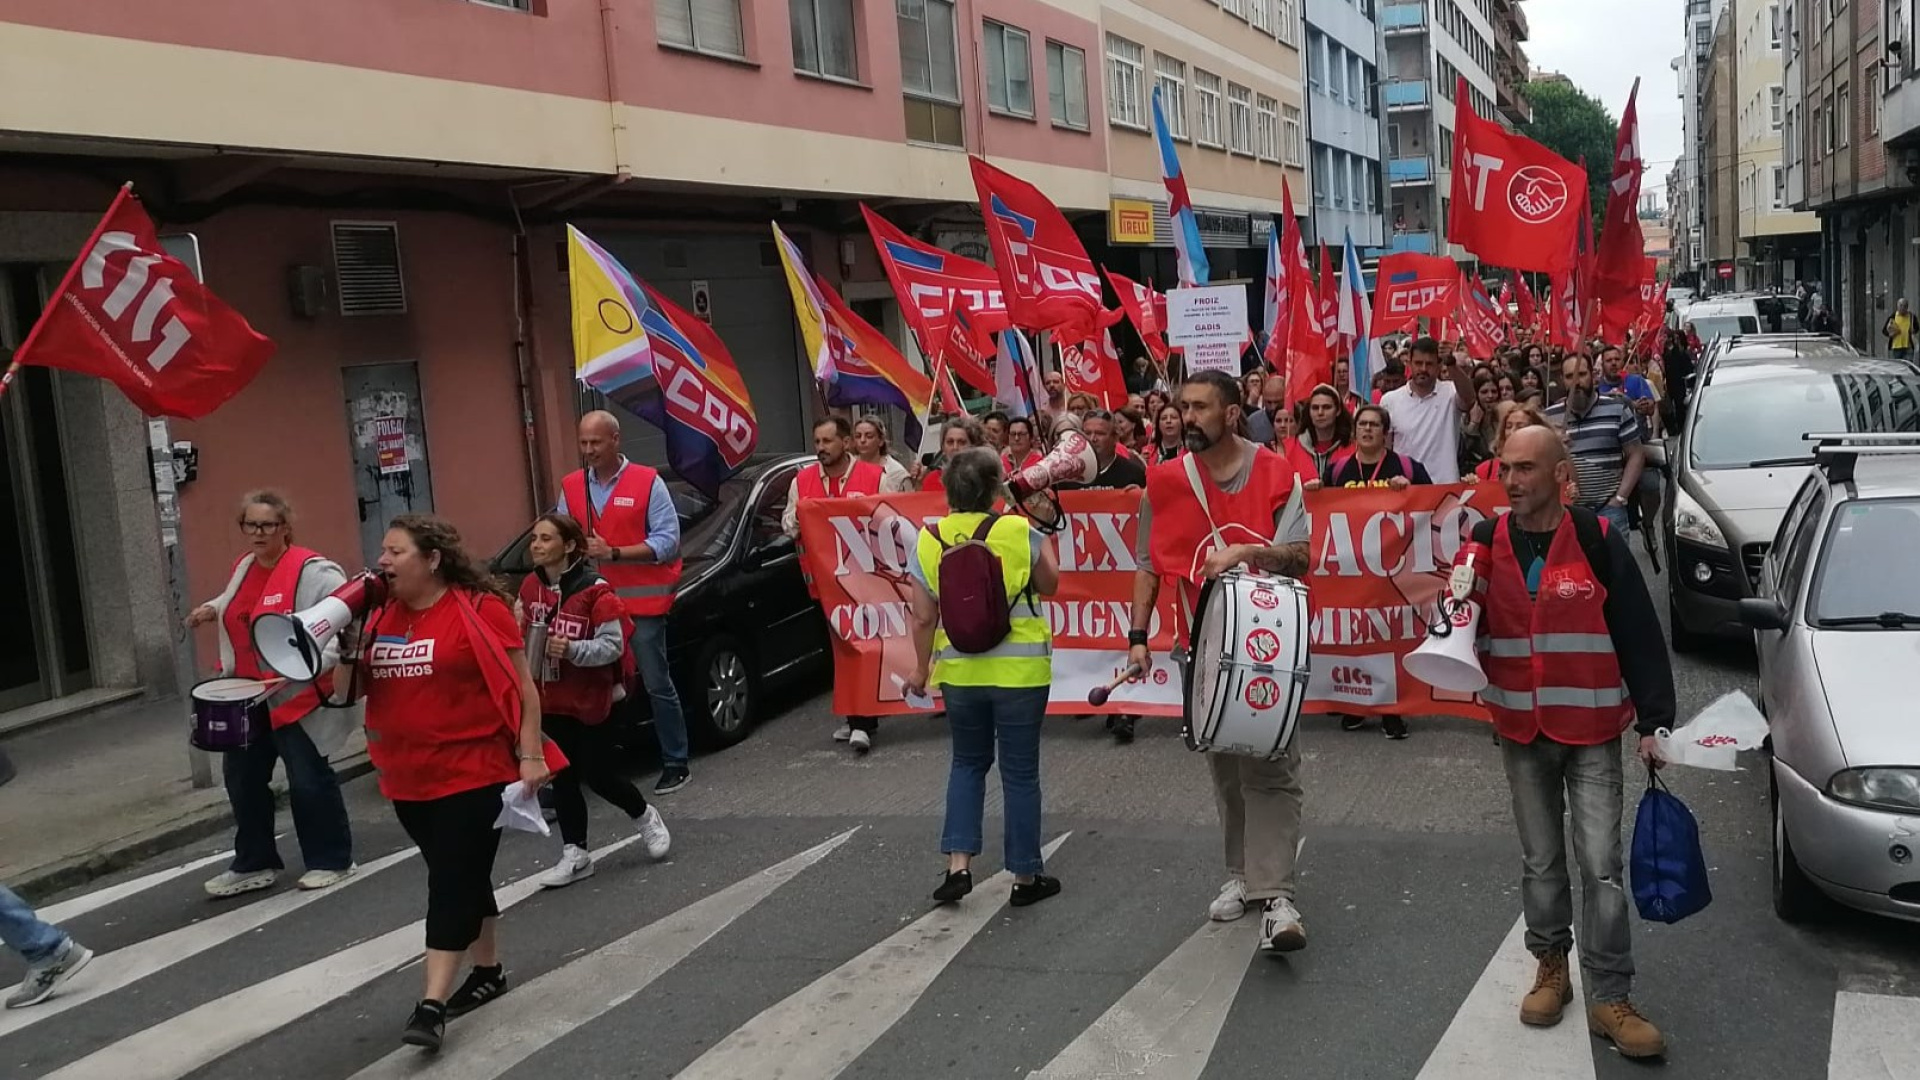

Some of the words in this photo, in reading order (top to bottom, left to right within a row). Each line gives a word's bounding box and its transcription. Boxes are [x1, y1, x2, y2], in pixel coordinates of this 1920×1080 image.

[1119, 210, 1149, 234] PIRELLI
[1194, 297, 1220, 305] FROIZ
[1194, 323, 1221, 331] GADIS
[132, 365, 153, 388] Galega
[376, 419, 403, 436] FOLGA
[373, 644, 428, 660] CCOO
[371, 663, 433, 679] servizos
[1333, 685, 1373, 696] SERVIZOS
